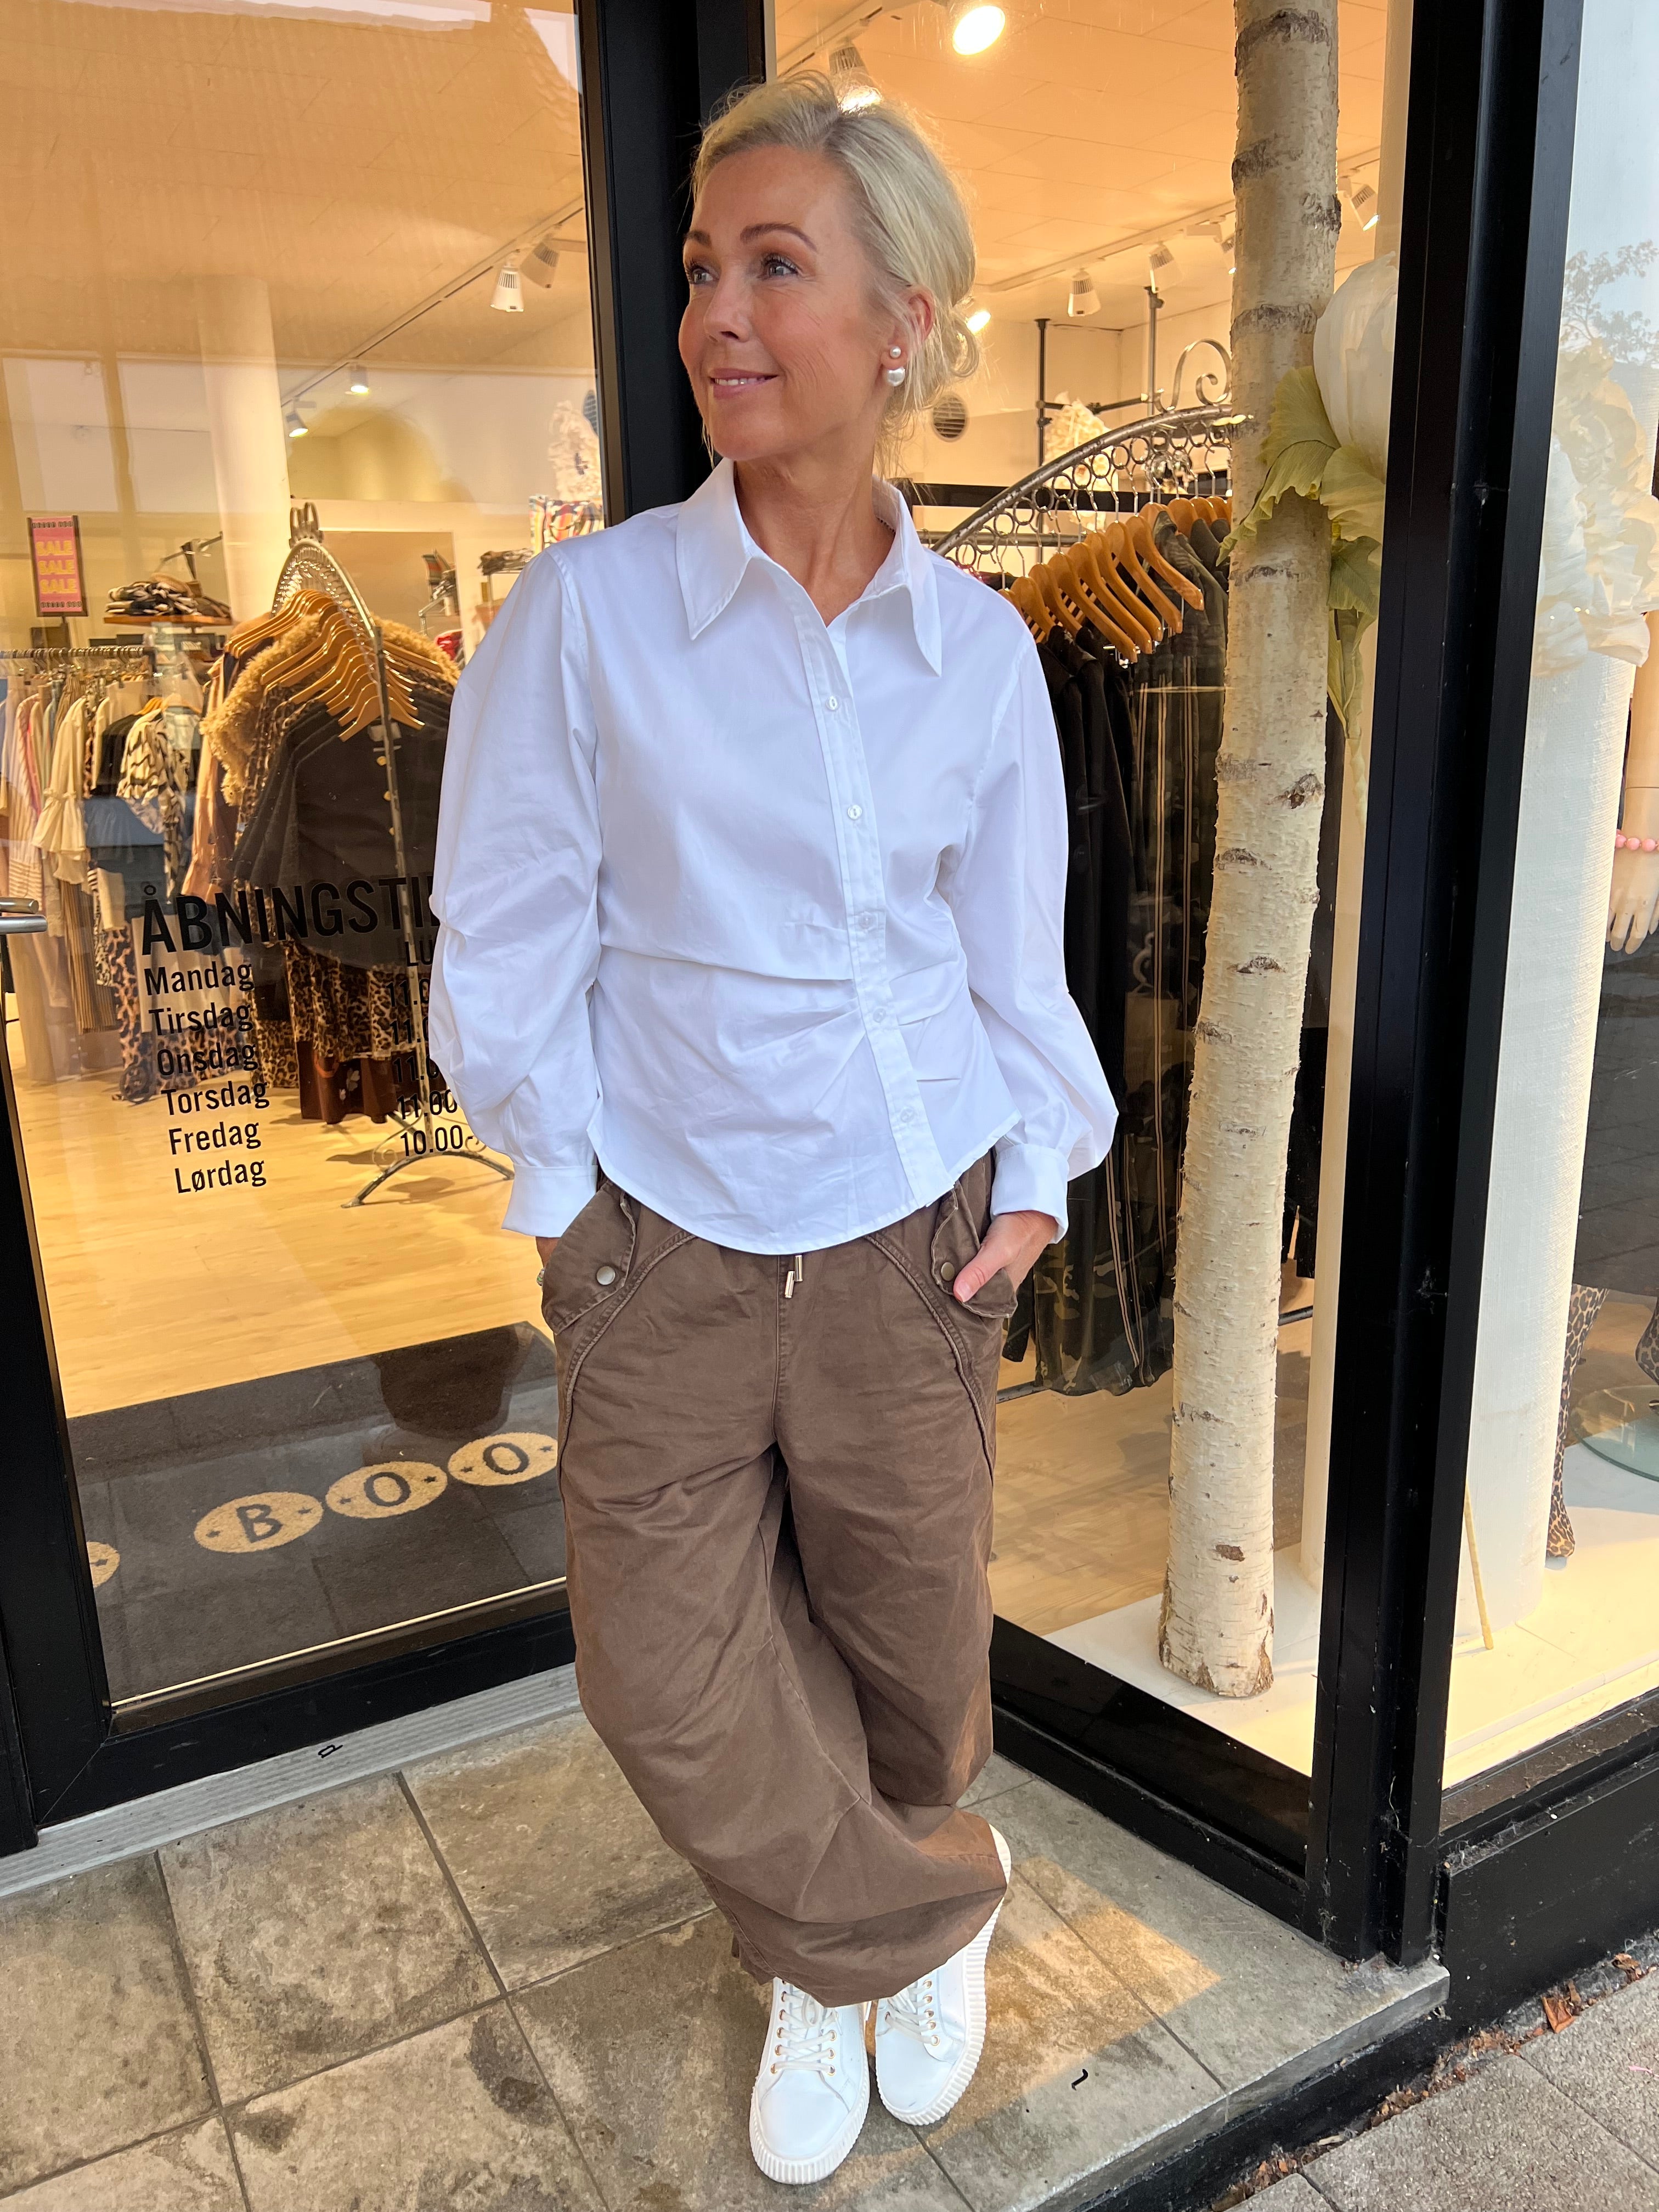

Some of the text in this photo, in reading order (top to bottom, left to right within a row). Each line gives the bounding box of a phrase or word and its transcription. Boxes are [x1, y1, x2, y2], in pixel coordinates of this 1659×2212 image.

[36, 540, 73, 556] SALE
[38, 560, 75, 575] SALE
[40, 579, 78, 594] SALE
[144, 961, 255, 996] Mandag
[149, 1002, 253, 1036] Tirsdag
[157, 1042, 258, 1076] Onsdag
[161, 1081, 270, 1116] Torsdag
[168, 1121, 262, 1155] Fredag
[175, 1160, 267, 1193] Lørdag
